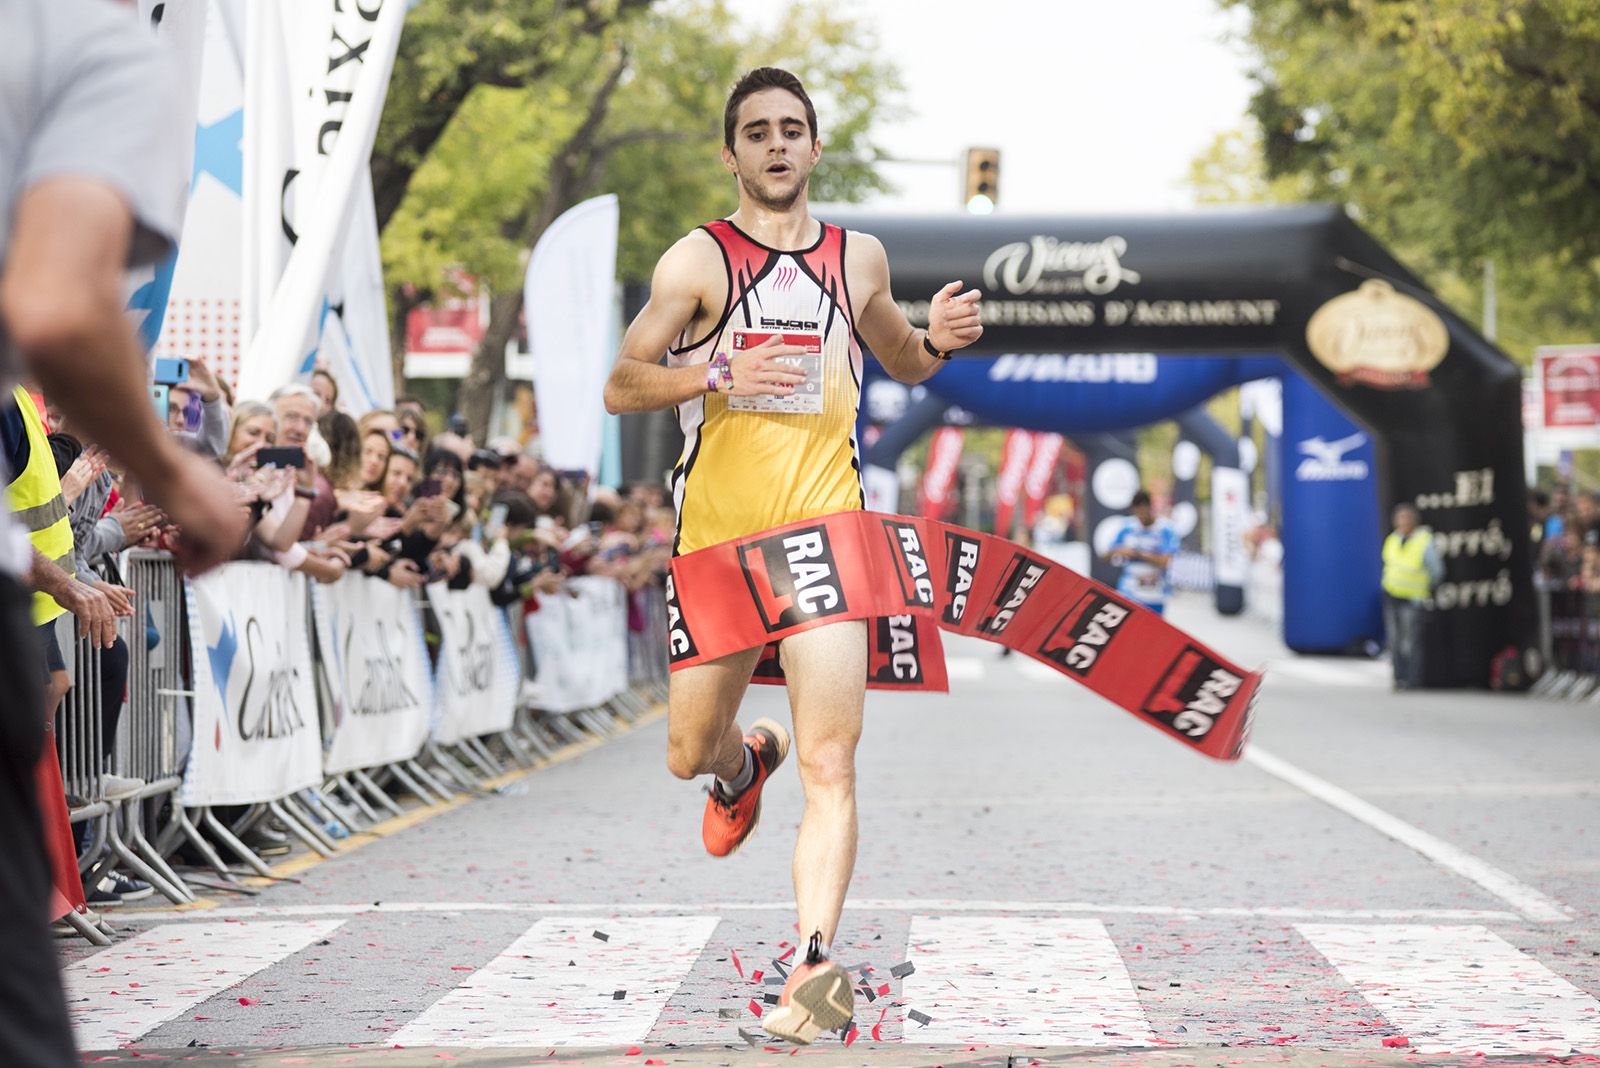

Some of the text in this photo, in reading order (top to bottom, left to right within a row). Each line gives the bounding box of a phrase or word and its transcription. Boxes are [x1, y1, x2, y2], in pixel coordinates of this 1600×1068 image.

[783, 530, 839, 615] RAC
[897, 527, 934, 605] RAC
[1431, 517, 1513, 562] orró,
[951, 540, 979, 621] RAC
[991, 563, 1048, 633] RAC
[1423, 567, 1513, 611] orró
[1064, 601, 1130, 670] RAC
[1172, 668, 1245, 738] RAC
